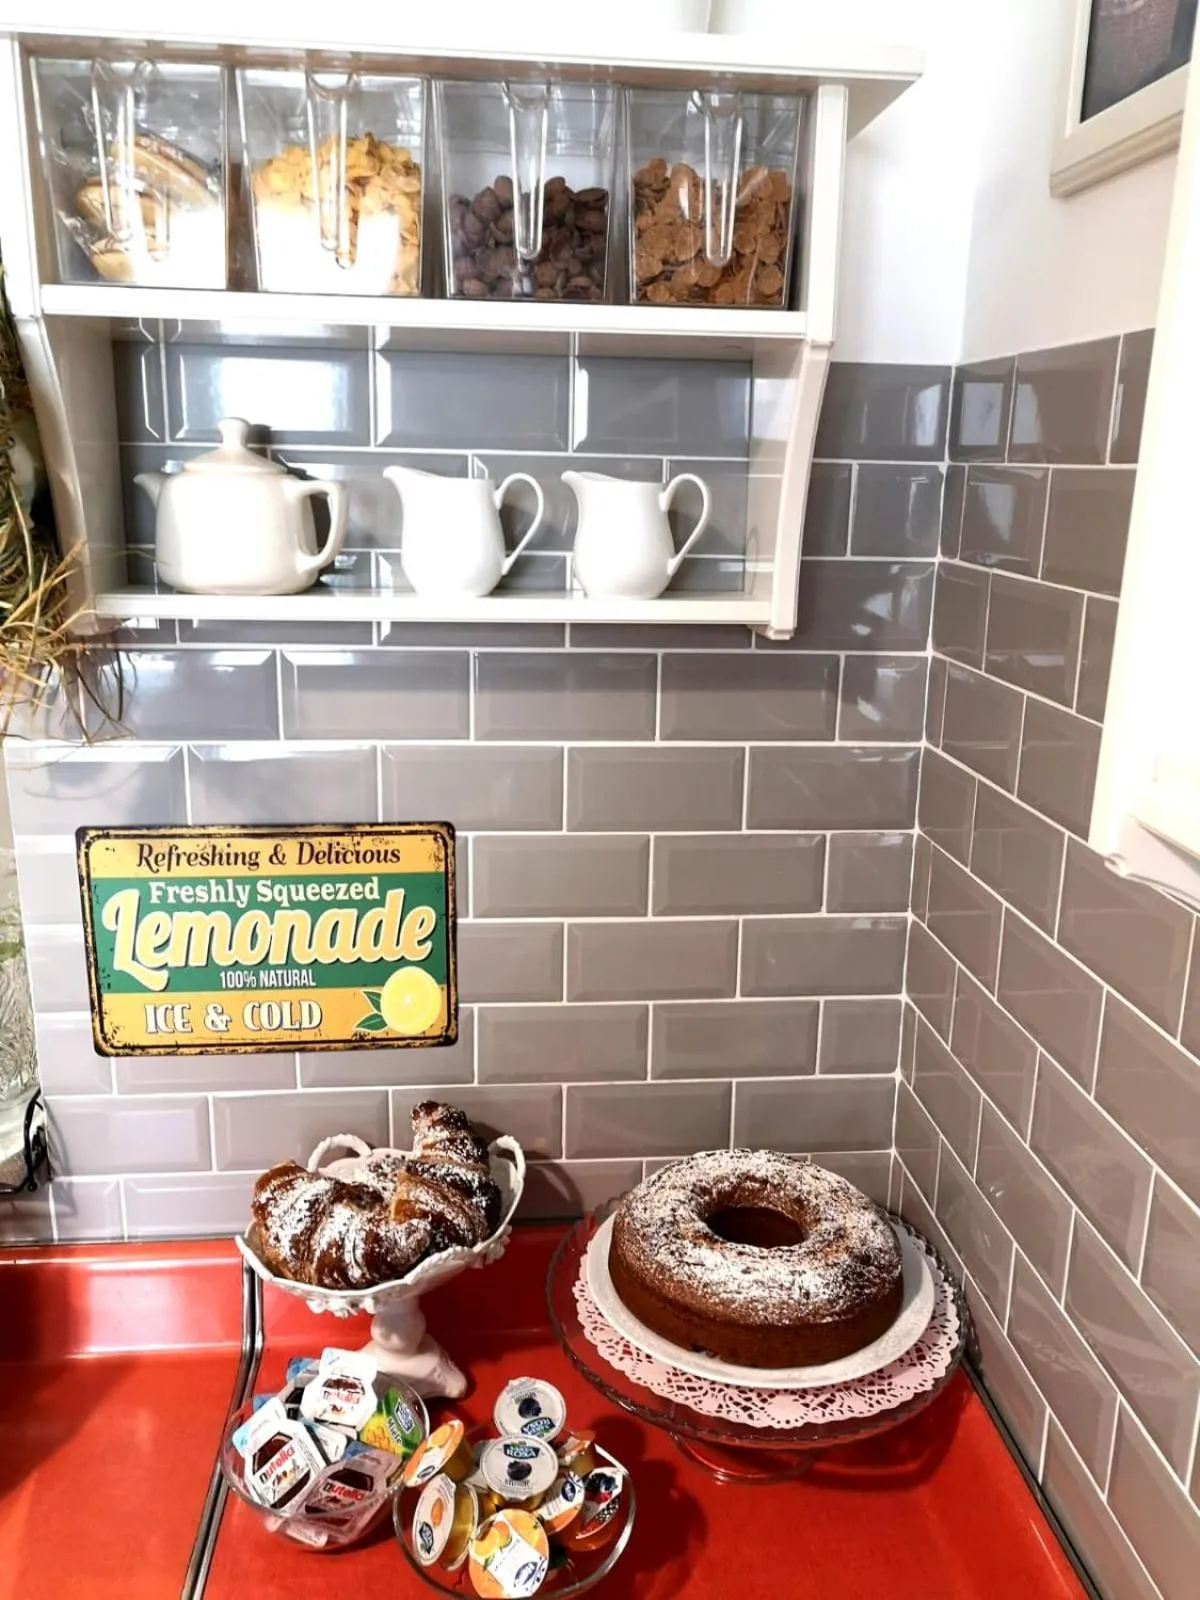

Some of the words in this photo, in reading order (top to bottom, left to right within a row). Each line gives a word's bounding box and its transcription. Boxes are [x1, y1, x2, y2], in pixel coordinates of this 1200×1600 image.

[136, 842, 260, 873] Refreshing
[269, 845, 288, 866] &
[297, 841, 401, 866] Delicious
[149, 879, 250, 909] Freshly
[257, 876, 380, 908] Squeezed
[101, 888, 437, 992] Lemonade
[219, 970, 257, 989] 100%
[260, 969, 316, 988] NATURAL
[144, 1001, 192, 1034] ICE
[204, 1001, 232, 1031] &
[243, 999, 323, 1031] COLD
[323, 1389, 360, 1405] nutella
[259, 1446, 296, 1485] nutella
[323, 1482, 366, 1501] nutella
